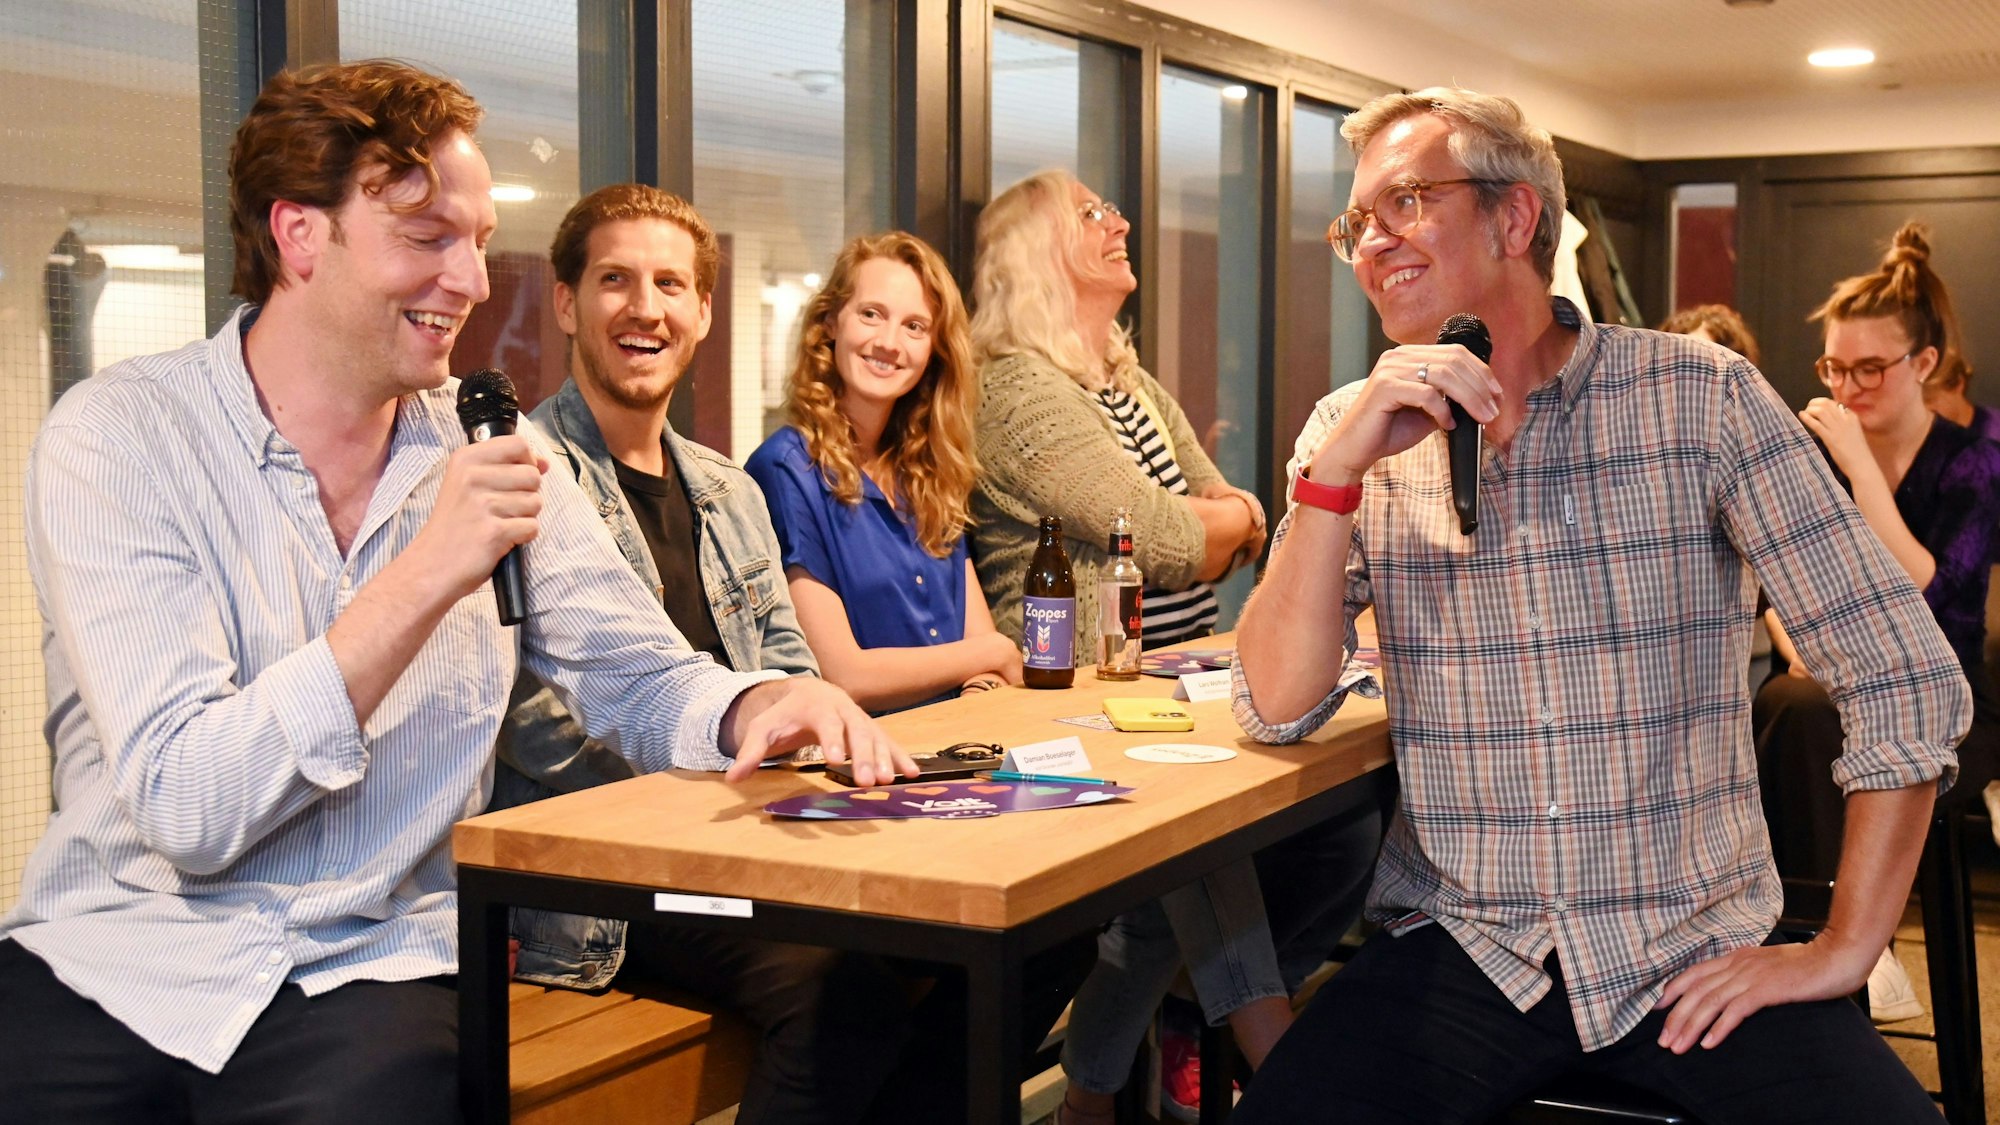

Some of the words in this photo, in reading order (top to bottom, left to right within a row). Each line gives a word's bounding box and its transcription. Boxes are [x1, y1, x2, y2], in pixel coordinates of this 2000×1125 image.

[1025, 602, 1067, 623] Zappes
[1023, 754, 1046, 764] Damian
[1045, 749, 1076, 760] Boeselager
[901, 797, 991, 809] Volt
